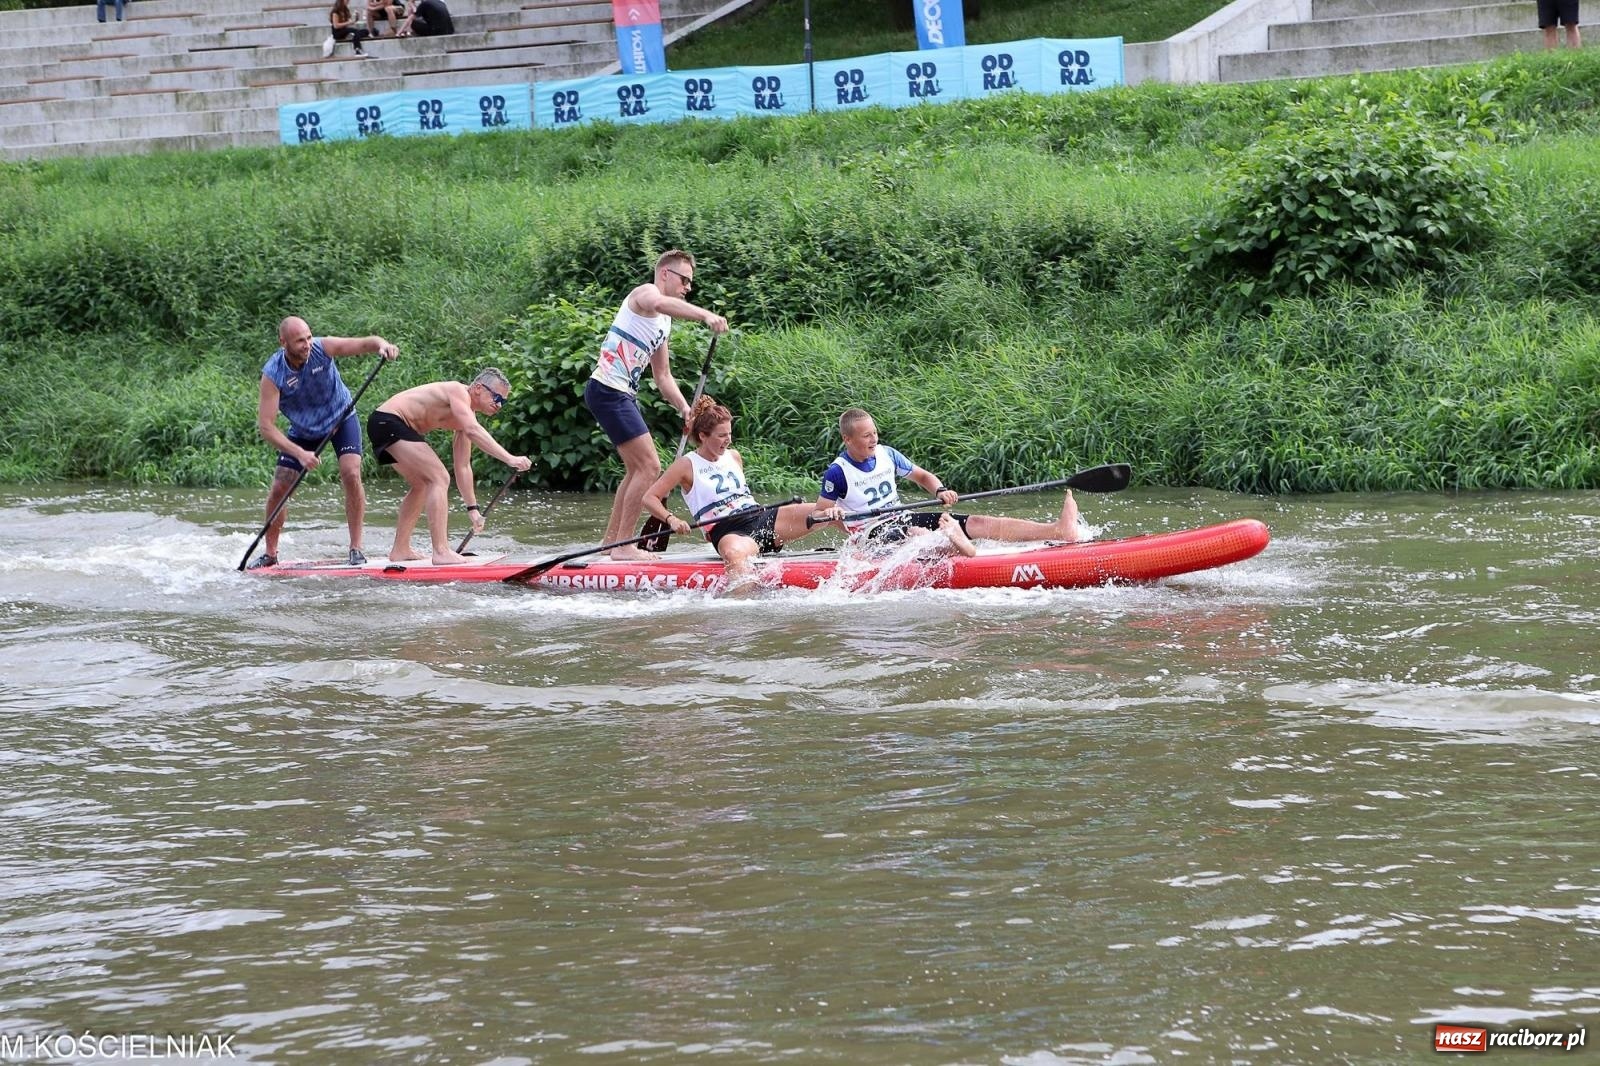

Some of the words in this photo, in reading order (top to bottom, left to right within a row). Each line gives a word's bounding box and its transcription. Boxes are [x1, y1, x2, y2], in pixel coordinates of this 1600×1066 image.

[924, 0, 944, 44] DEC
[981, 54, 1013, 72] OD
[1058, 50, 1090, 67] OD
[834, 69, 864, 87] OD
[906, 62, 936, 79] OD
[1061, 68, 1090, 85] RA
[685, 79, 713, 94] OD
[752, 76, 780, 92] OD
[909, 80, 936, 97] RA
[984, 71, 1012, 90] RA
[552, 91, 579, 106] OD
[617, 84, 645, 100] OD
[837, 86, 864, 103] RA
[417, 99, 443, 114] OD
[479, 95, 505, 111] OD
[621, 101, 645, 117] RA
[687, 96, 711, 110] RA
[754, 94, 780, 109] RA
[296, 112, 320, 126] OD
[356, 106, 381, 121] OD
[481, 111, 504, 127] RA
[554, 106, 577, 122] RA
[420, 115, 443, 130] RA
[298, 128, 320, 143] RA
[709, 471, 741, 495] 21
